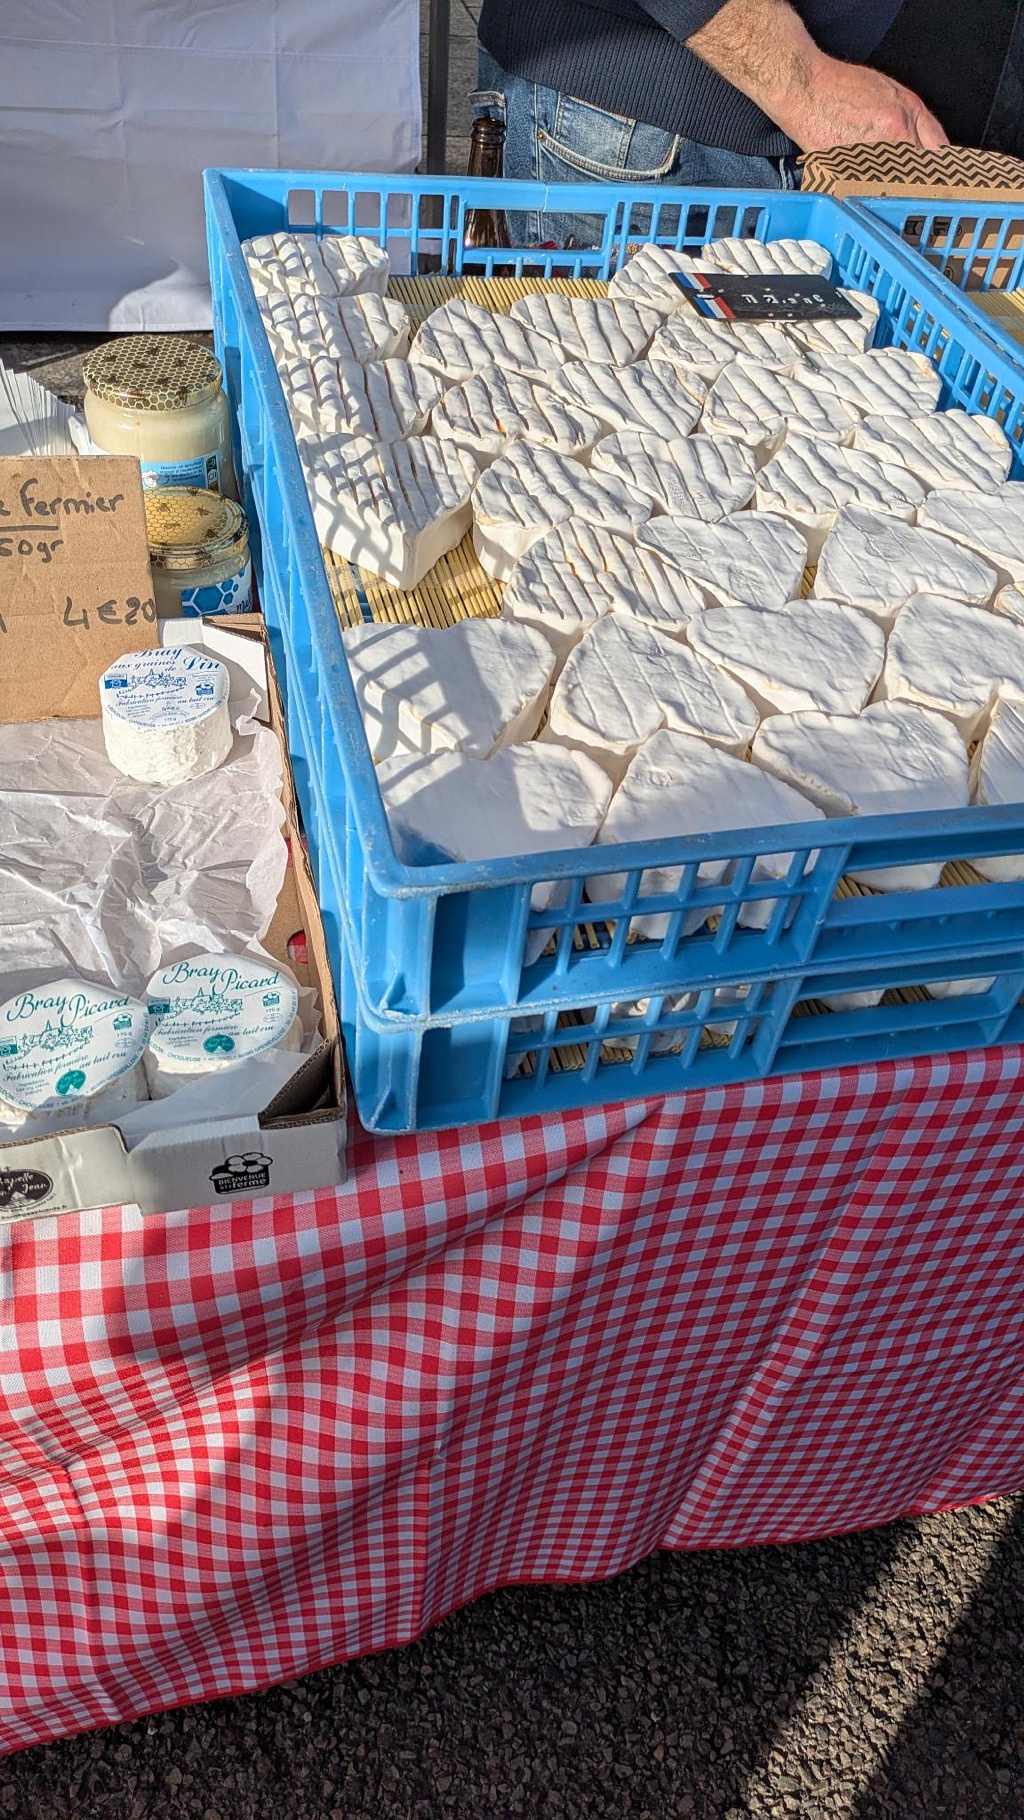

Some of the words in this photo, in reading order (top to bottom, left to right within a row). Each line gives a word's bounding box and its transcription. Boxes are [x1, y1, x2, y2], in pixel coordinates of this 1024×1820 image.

[19, 477, 124, 517] fermier
[133, 659, 176, 671] graines
[182, 656, 220, 671] Lin
[163, 962, 220, 985] Bray
[212, 968, 280, 1000] Picard
[7, 993, 68, 1022] Bray
[60, 993, 130, 1028] Picard
[155, 1024, 201, 1036] Fabrication
[242, 1025, 259, 1036] lait
[80, 1062, 91, 1070] au
[93, 1051, 111, 1065] lait
[3, 1067, 54, 1082] Fabrication
[218, 1172, 267, 1185] BIENVENUE
[232, 1178, 267, 1189] ferme
